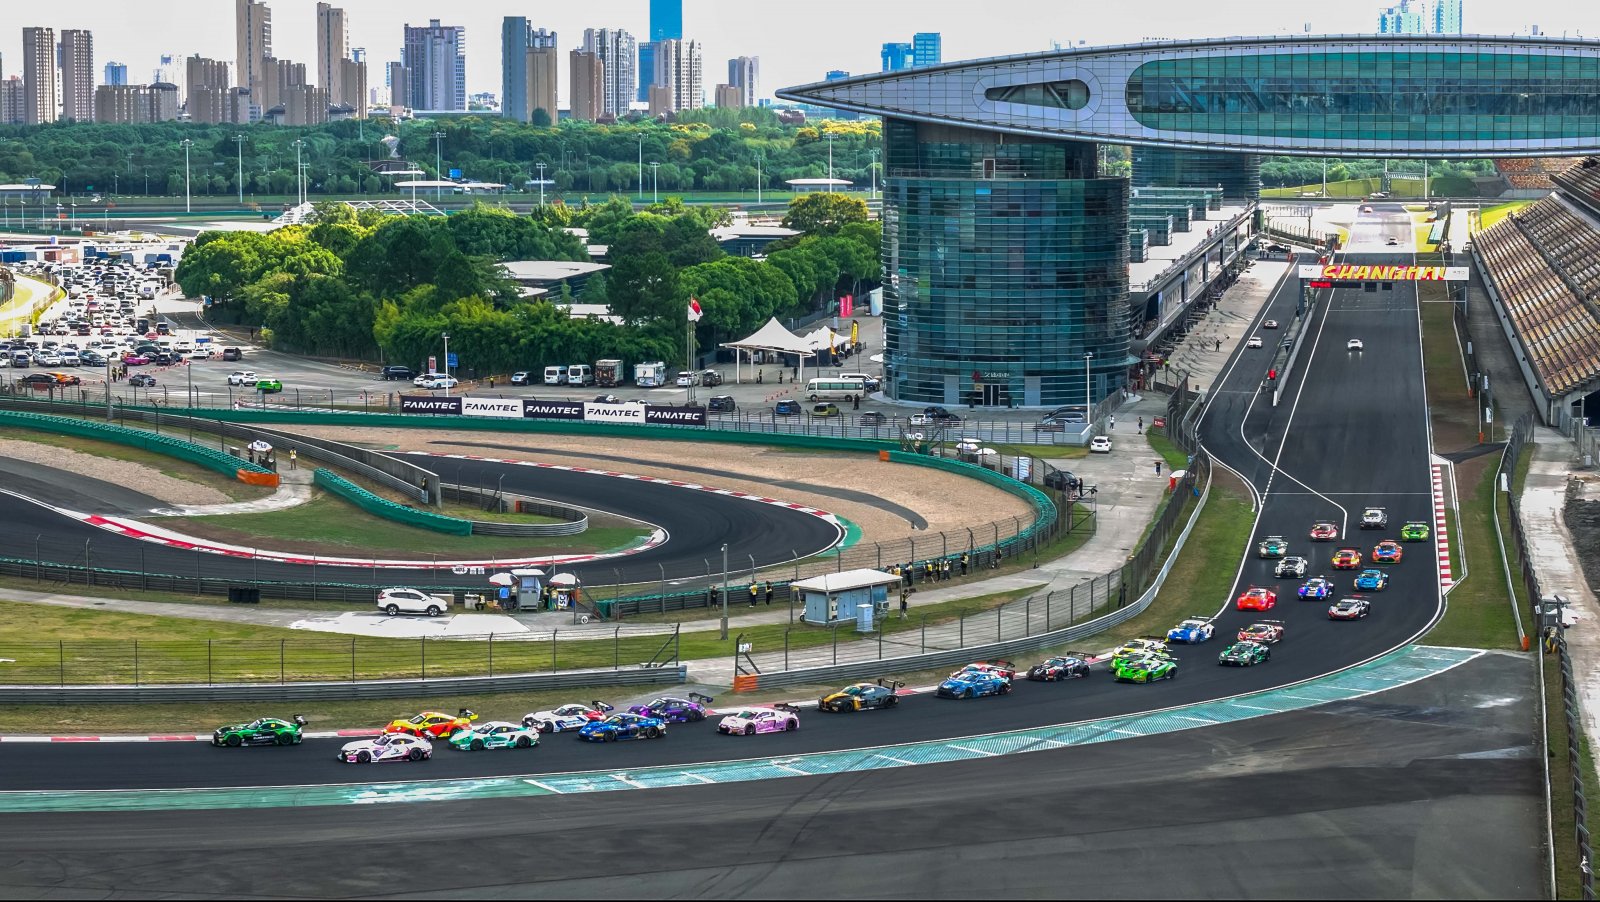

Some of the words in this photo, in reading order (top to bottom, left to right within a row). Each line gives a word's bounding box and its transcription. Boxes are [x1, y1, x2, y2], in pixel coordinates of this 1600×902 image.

[403, 401, 457, 410] FANATEC
[465, 403, 518, 412] FANATEC
[525, 405, 580, 415] FANATEC
[587, 408, 640, 417] FANATEC
[647, 411, 700, 420] FANATEC
